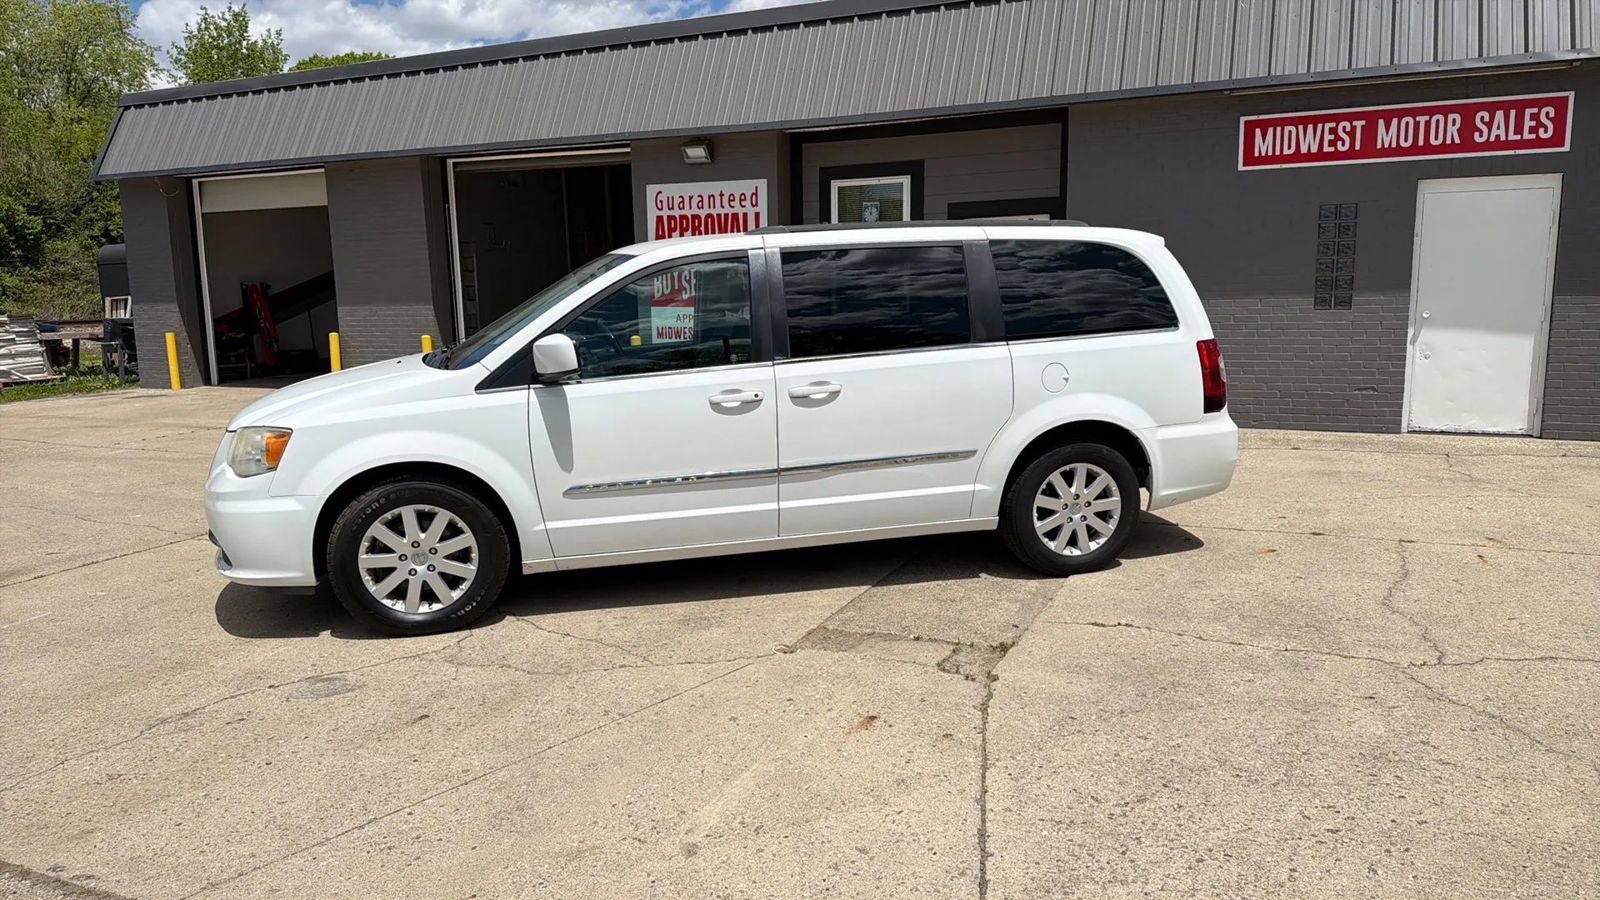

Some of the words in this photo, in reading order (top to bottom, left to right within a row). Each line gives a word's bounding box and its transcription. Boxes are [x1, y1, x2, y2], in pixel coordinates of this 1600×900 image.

[1253, 120, 1366, 157] MIDWEST
[1376, 113, 1461, 149] MOTOR
[1473, 106, 1556, 143] SALES
[655, 186, 759, 211] Guaranteed
[654, 271, 679, 299] BUY
